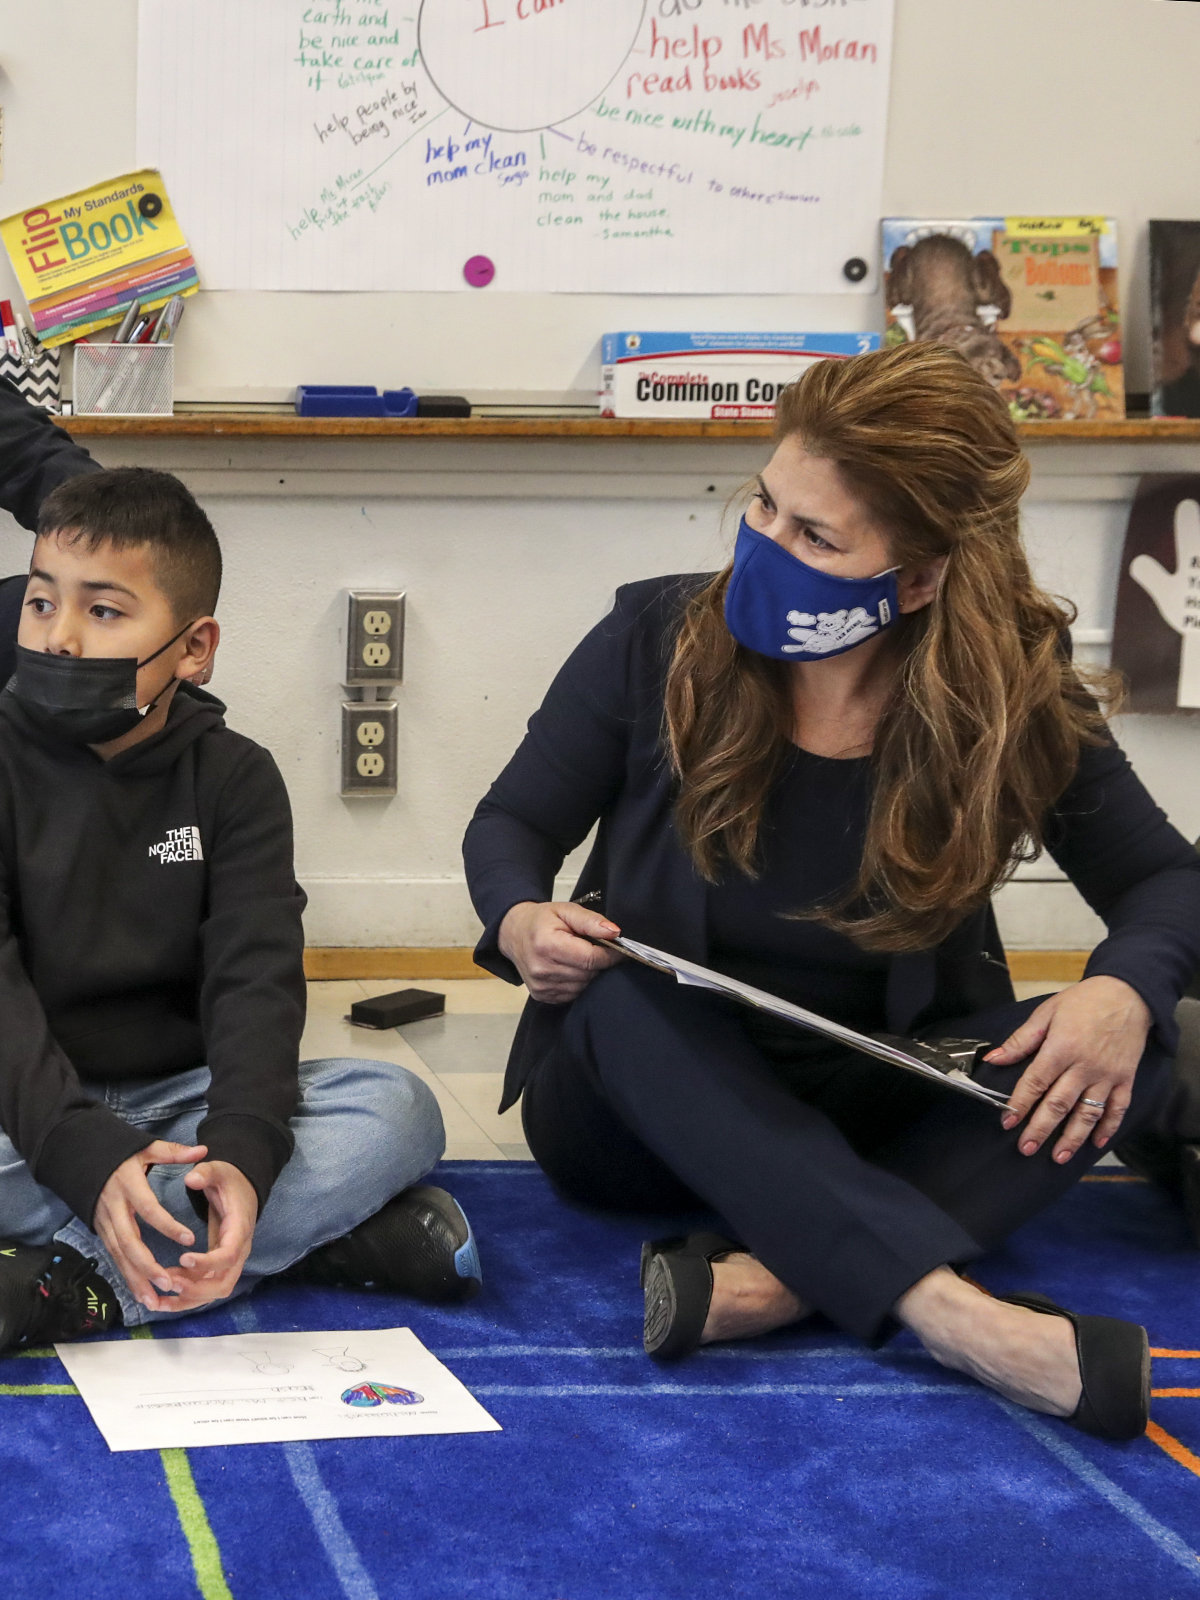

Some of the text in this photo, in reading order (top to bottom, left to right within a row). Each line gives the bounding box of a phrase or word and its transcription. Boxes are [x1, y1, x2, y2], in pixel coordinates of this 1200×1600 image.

[302, 9, 389, 27] earth and
[299, 29, 399, 50] be nice and
[650, 17, 878, 69] help Ms Moran
[294, 49, 420, 70] take care of
[627, 66, 692, 98] read
[313, 80, 418, 144] help people by
[352, 99, 418, 147] being nice
[596, 97, 621, 119] be
[625, 107, 664, 129] nice
[672, 108, 715, 134] with
[719, 125, 746, 148] my
[750, 112, 814, 152] heart
[425, 133, 493, 163] help my
[427, 150, 526, 186] mom clean
[539, 166, 611, 188] help my
[602, 146, 693, 184] respectful
[63, 182, 145, 220] My Standards
[538, 188, 653, 203] mom and dad
[58, 199, 158, 261] Book
[537, 212, 584, 227] clean
[599, 211, 621, 222] the
[21, 207, 68, 274] Flip
[636, 378, 739, 402] Common
[651, 371, 709, 388] Complete
[166, 826, 192, 841] THE
[148, 838, 193, 857] NORTH
[160, 849, 193, 864] FACE
